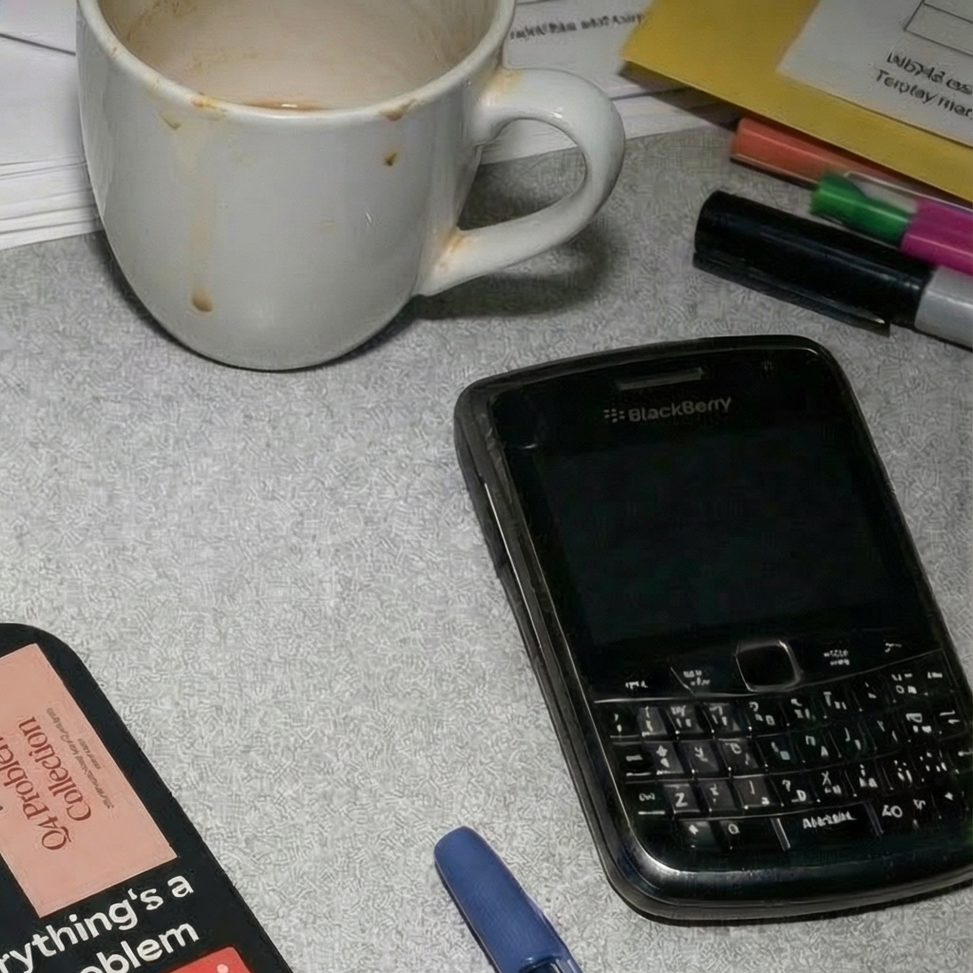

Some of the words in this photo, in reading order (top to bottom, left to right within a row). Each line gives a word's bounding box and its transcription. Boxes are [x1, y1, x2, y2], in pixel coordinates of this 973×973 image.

[628, 396, 732, 422] BlackBerry
[18, 716, 91, 821] Collection
[38, 816, 71, 850] Q4
[166, 875, 194, 897] a
